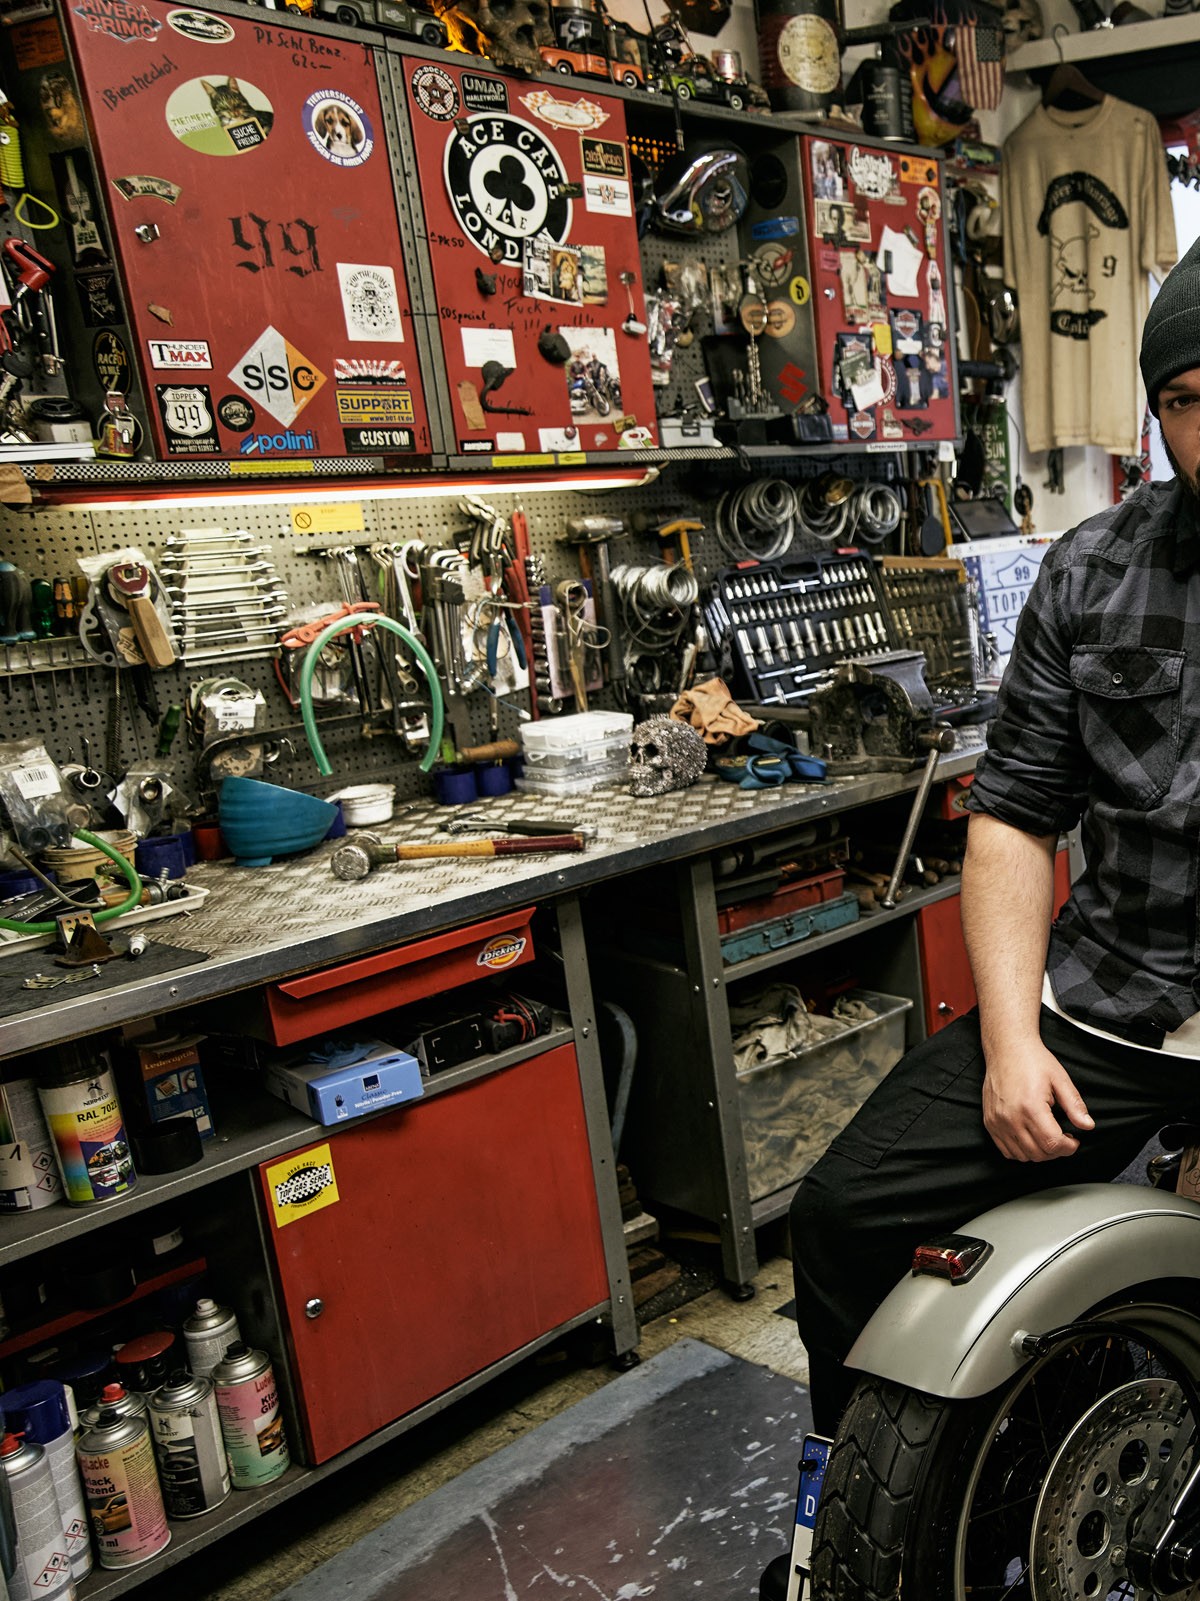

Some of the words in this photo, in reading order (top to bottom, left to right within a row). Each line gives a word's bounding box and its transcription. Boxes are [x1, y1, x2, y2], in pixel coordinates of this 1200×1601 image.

[86, 14, 157, 39] PRIMO
[463, 77, 504, 95] UMAP
[307, 90, 364, 115] TIERVERSUCHE?
[233, 124, 257, 139] SUCHE
[237, 134, 261, 148] FREUND
[308, 131, 331, 161] FRAGEN
[331, 155, 343, 165] SIE
[459, 121, 505, 158] ACE
[517, 131, 560, 199] CAFE
[456, 193, 557, 259] LONDN
[485, 202, 528, 230] ACE
[168, 351, 209, 362] MAX
[339, 398, 410, 410] SUPPORT
[174, 404, 202, 429] 99
[258, 429, 315, 454] polini
[360, 431, 410, 446] CUSTOM
[1014, 566, 1030, 581] 99
[483, 942, 521, 962] Dickies
[77, 1111, 99, 1123] RAL
[279, 1187, 292, 1199] TOP
[293, 1180, 308, 1193] GAS
[309, 1171, 329, 1186] SERIE
[805, 1494, 816, 1516] D
